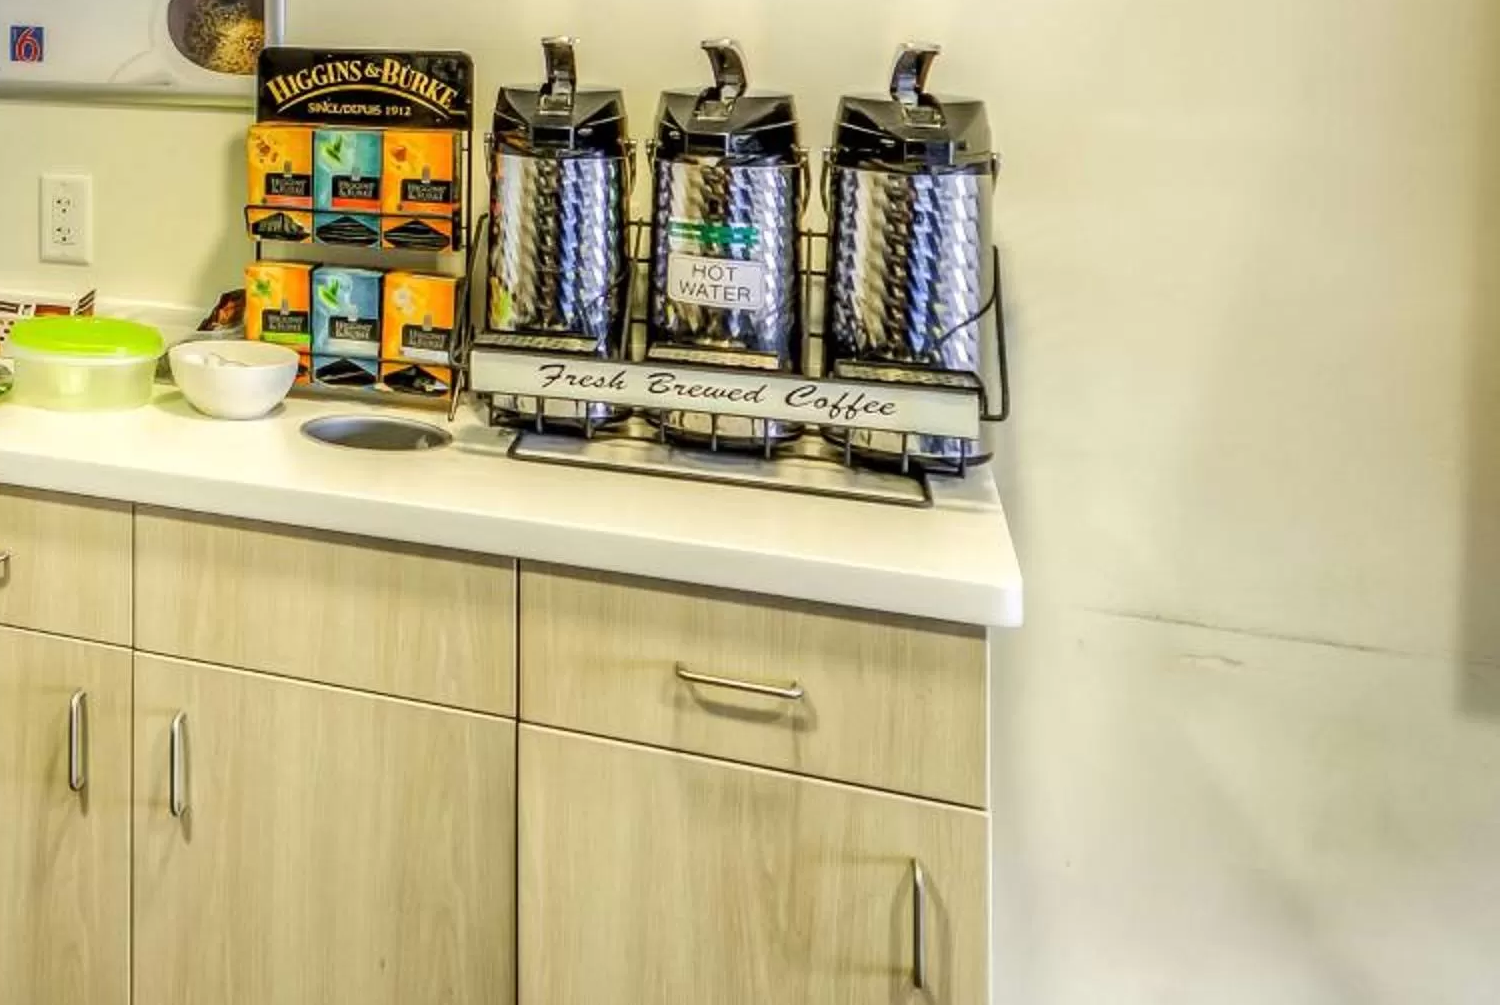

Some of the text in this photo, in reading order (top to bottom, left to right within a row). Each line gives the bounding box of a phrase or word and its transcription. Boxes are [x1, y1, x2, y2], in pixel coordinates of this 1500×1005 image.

[266, 58, 458, 109] HIGGINS & BURKE
[385, 106, 412, 117] 1912
[692, 263, 739, 282] HOT
[679, 279, 752, 302] WATER
[538, 363, 897, 420] Fresh Brewed Coffee
